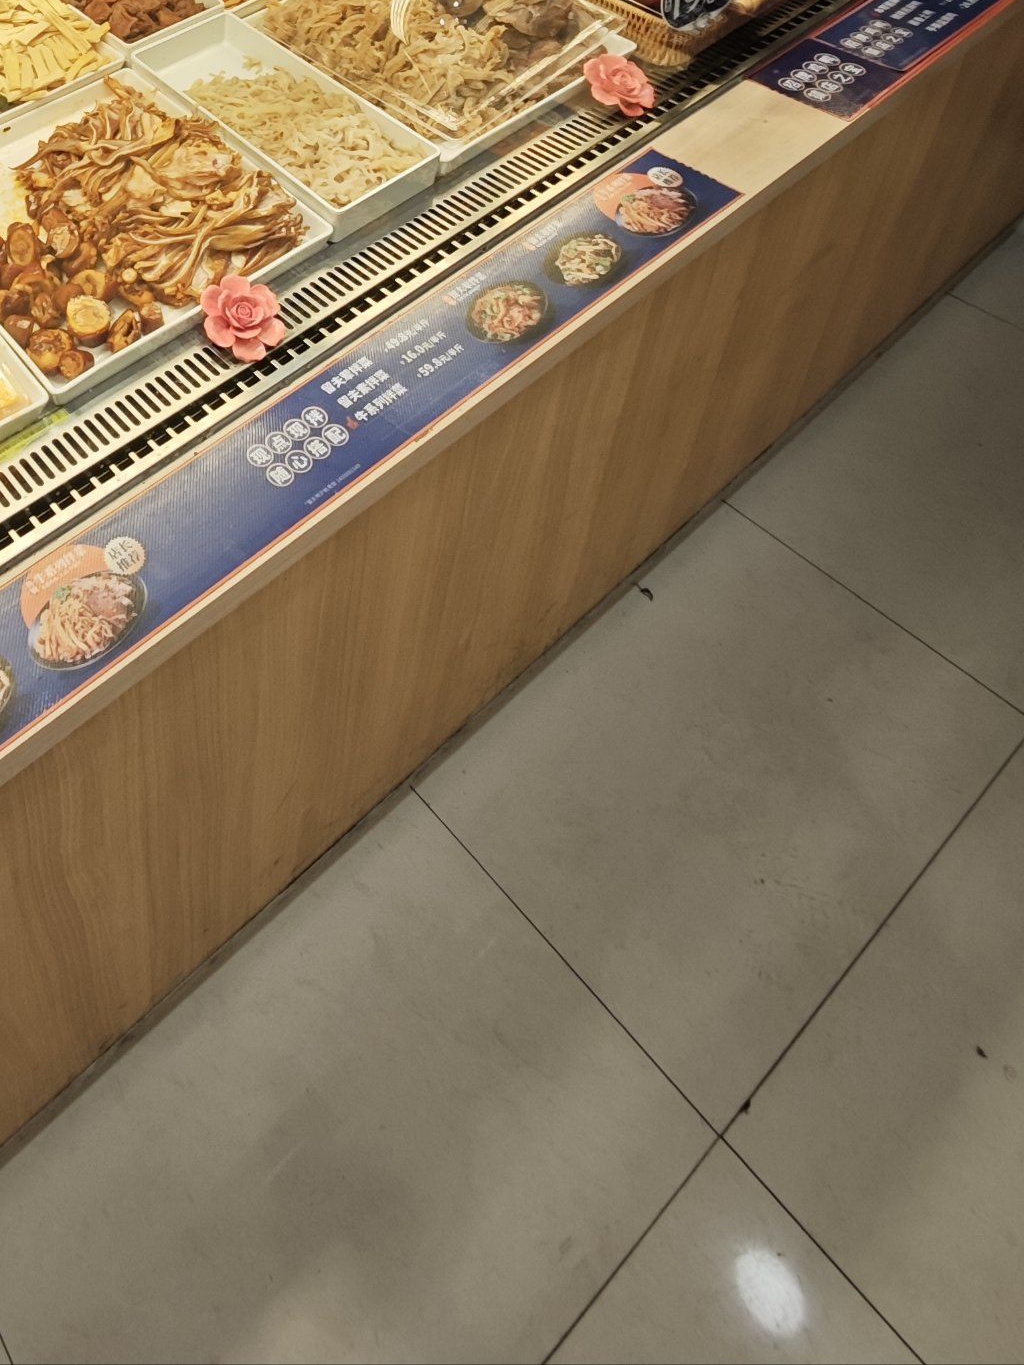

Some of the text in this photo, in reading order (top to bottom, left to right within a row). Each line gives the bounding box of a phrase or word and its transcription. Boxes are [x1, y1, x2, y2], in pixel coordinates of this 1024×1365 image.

[249, 408, 326, 465] 现点现拌
[268, 426, 348, 485] 随心搭配
